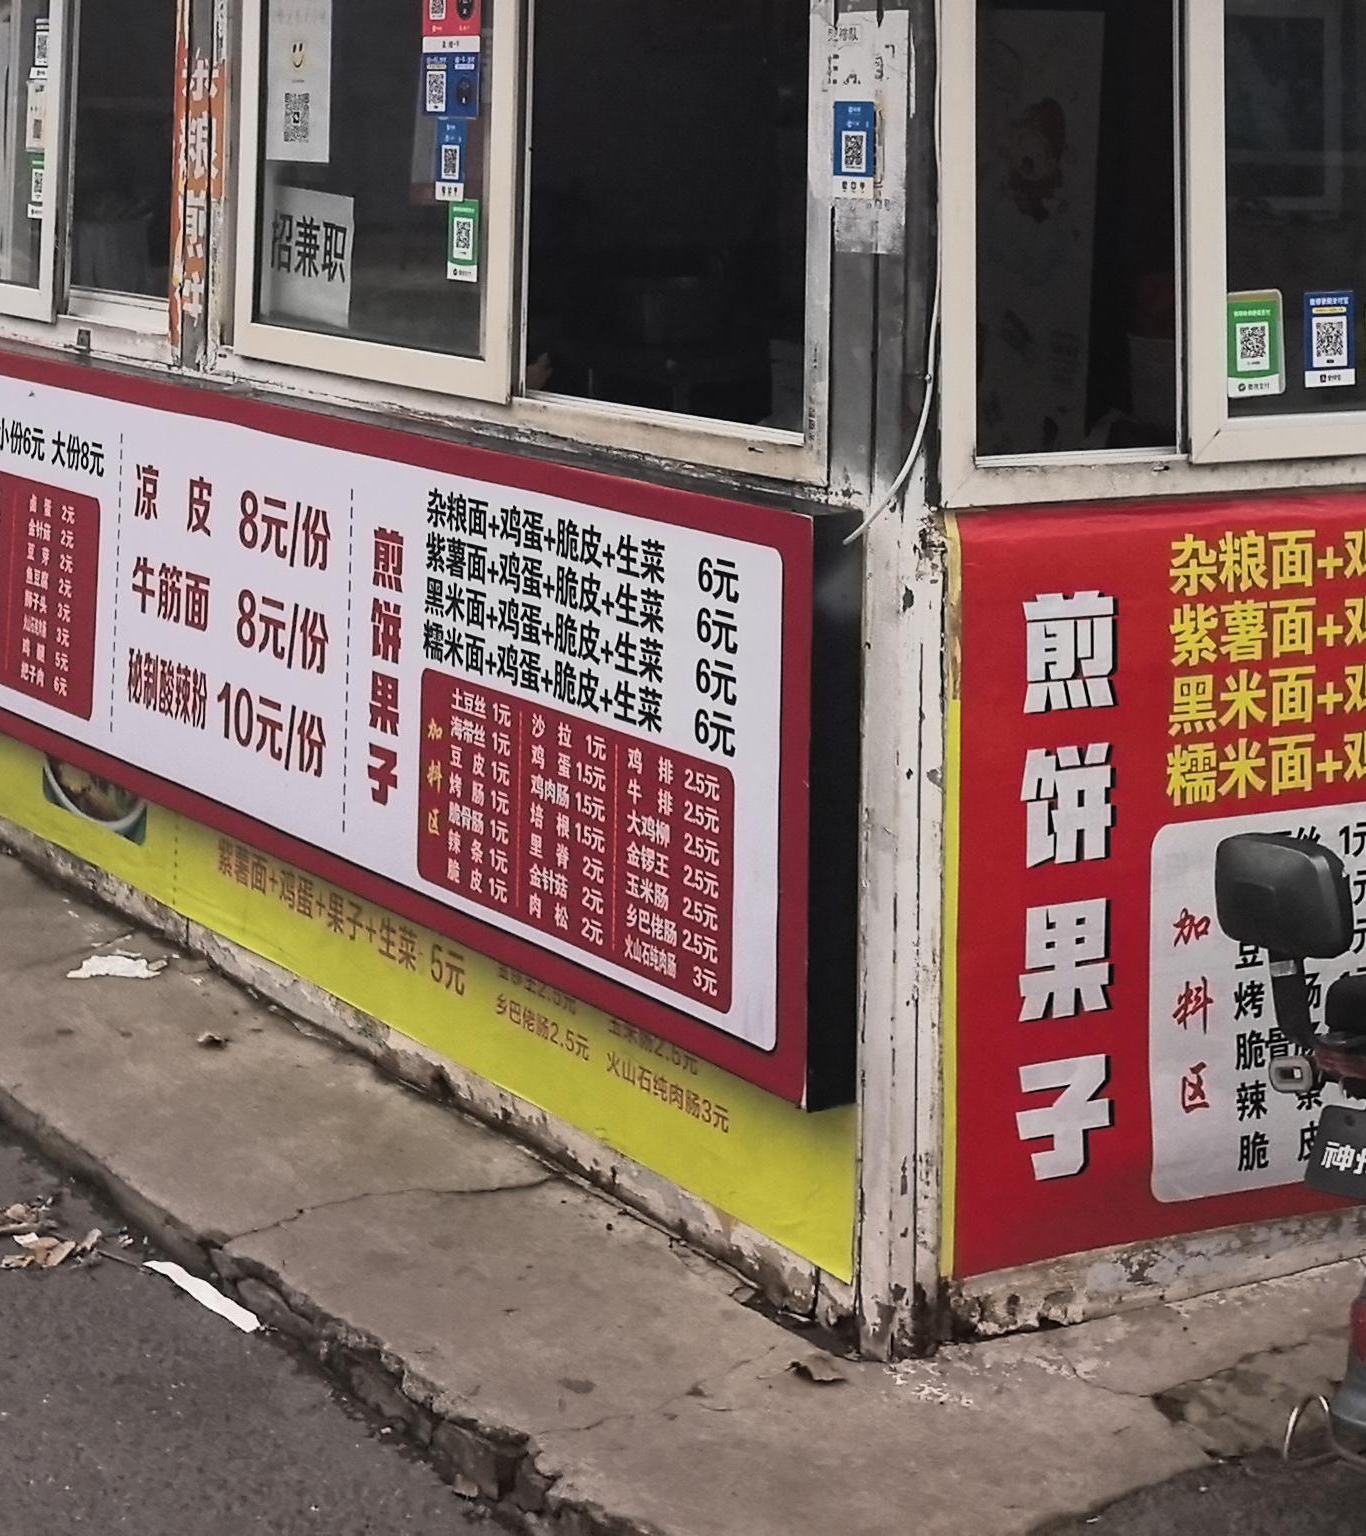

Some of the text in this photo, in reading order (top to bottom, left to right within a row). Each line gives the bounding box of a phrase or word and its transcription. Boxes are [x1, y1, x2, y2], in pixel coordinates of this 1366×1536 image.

[271, 210, 347, 283] 招兼职
[51, 430, 105, 478] 大份8元
[28, 518, 74, 549] 金针菇 2元
[62, 505, 75, 525] 2元
[134, 463, 331, 571] 凉皮 8元/份
[60, 554, 74, 574] 2元
[427, 488, 739, 603] 杂粮面+鸡蛋+脆皮+生菜 6元
[58, 578, 72, 599] 2元
[426, 531, 738, 655] 紫薯面+鸡蛋+脆皮+生菜 6元
[57, 602, 72, 623] 3元
[132, 556, 328, 674] 牛筋面 8元/份
[56, 627, 70, 648] 3元
[424, 576, 737, 705] 黑米面+鸡蛋+脆皮+生菜 6元
[54, 651, 69, 673] 5元
[367, 526, 404, 806] 煎饼果子
[53, 676, 68, 697] 6元
[423, 622, 736, 757] 糯米面+鸡蛋+脆皮+生菜 6元
[450, 688, 511, 727] 土豆丝 1元
[128, 648, 326, 778] 秘制酸辣粉 10元/份
[450, 716, 511, 756] 海带丝 1元
[531, 712, 606, 761] 沙拉 1元
[427, 721, 443, 836] 加料区
[449, 745, 510, 786] 豆皮 1元
[531, 745, 571, 779] 鸡蛋
[627, 747, 674, 783] 鸡排
[449, 773, 509, 815] 烤肠 1元
[530, 774, 570, 809] 鸡肉肠
[626, 779, 673, 816] 牛排
[448, 802, 509, 845] 脆骨肠 1元
[530, 805, 570, 839] 培根
[626, 811, 670, 847] 大鸡柳
[447, 829, 508, 874] 辣条 1元
[530, 834, 604, 884] 里脊 2元
[447, 857, 507, 903] 脆皮 1元
[529, 864, 603, 915] 金针菇 2元
[626, 874, 668, 911] 玉米肠
[1017, 591, 1119, 1184] 煎饼果子
[529, 894, 603, 945] 肉松 2元
[625, 904, 677, 947] 乡巴佬肠
[624, 934, 718, 996] 火山石纯肉肠 3元
[1172, 909, 1213, 1113] 加料区
[495, 994, 729, 1133] 乡巴佬肠2.5元 火山石纯肉肠3元
